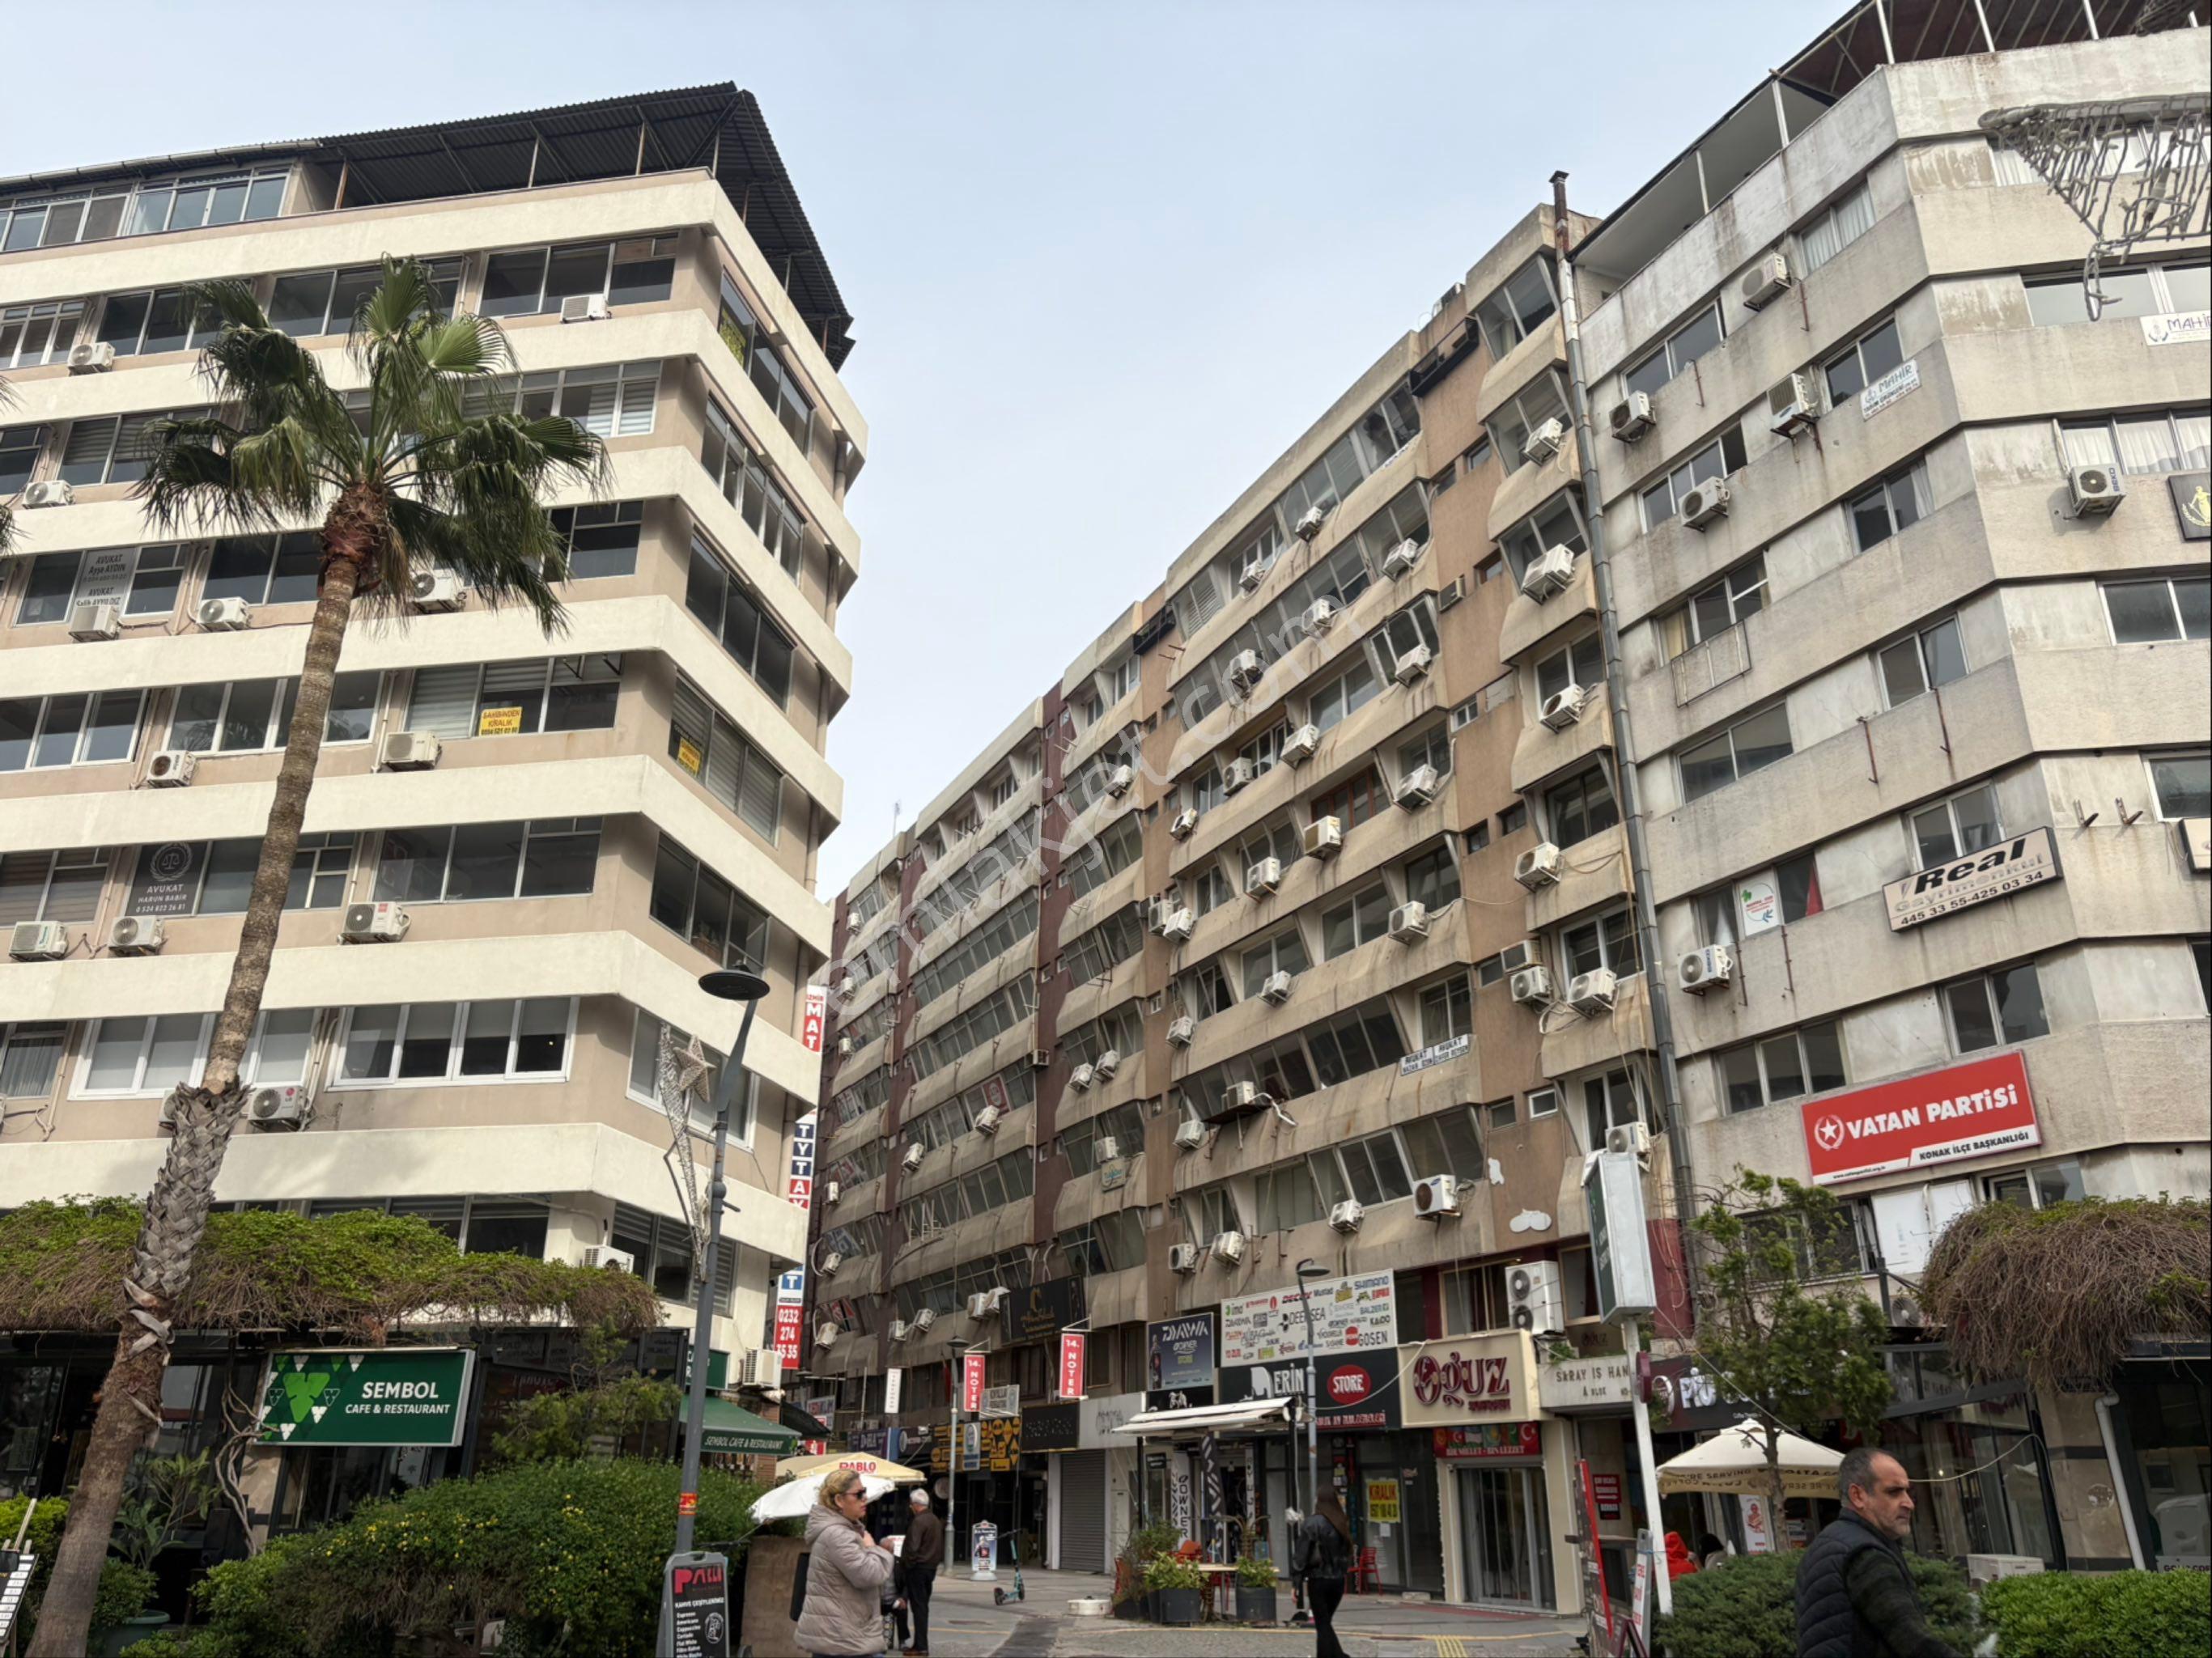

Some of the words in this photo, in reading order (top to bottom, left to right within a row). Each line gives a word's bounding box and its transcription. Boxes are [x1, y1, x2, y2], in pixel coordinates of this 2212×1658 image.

[1914, 837, 2026, 894] Real
[146, 884, 185, 894] AVUKAT
[1901, 910, 1926, 926] 445
[1930, 904, 1947, 917] 33
[1951, 888, 1998, 909] 55-425
[2002, 880, 2021, 892] 03
[2025, 871, 2044, 884] 34
[1846, 1106, 1921, 1140] VATAN
[1925, 1083, 2019, 1123] PARTİSİ
[1919, 1147, 1951, 1160] KONAK
[1953, 1142, 1972, 1156] İLÇE
[1973, 1130, 2029, 1150] BAŞKANLIĞI
[1354, 1276, 1389, 1290] SHIMANO
[778, 1308, 800, 1324] 0232
[779, 1326, 796, 1342] 274
[1067, 1351, 1077, 1395] NOTER
[362, 1381, 439, 1399] SEMBOL
[970, 1371, 979, 1410] NOTER
[1332, 1374, 1365, 1394] STORE
[345, 1404, 371, 1414] CAFE
[372, 1404, 382, 1414] &
[384, 1403, 451, 1414] RESTAURANT
[839, 1461, 877, 1472] PABLO
